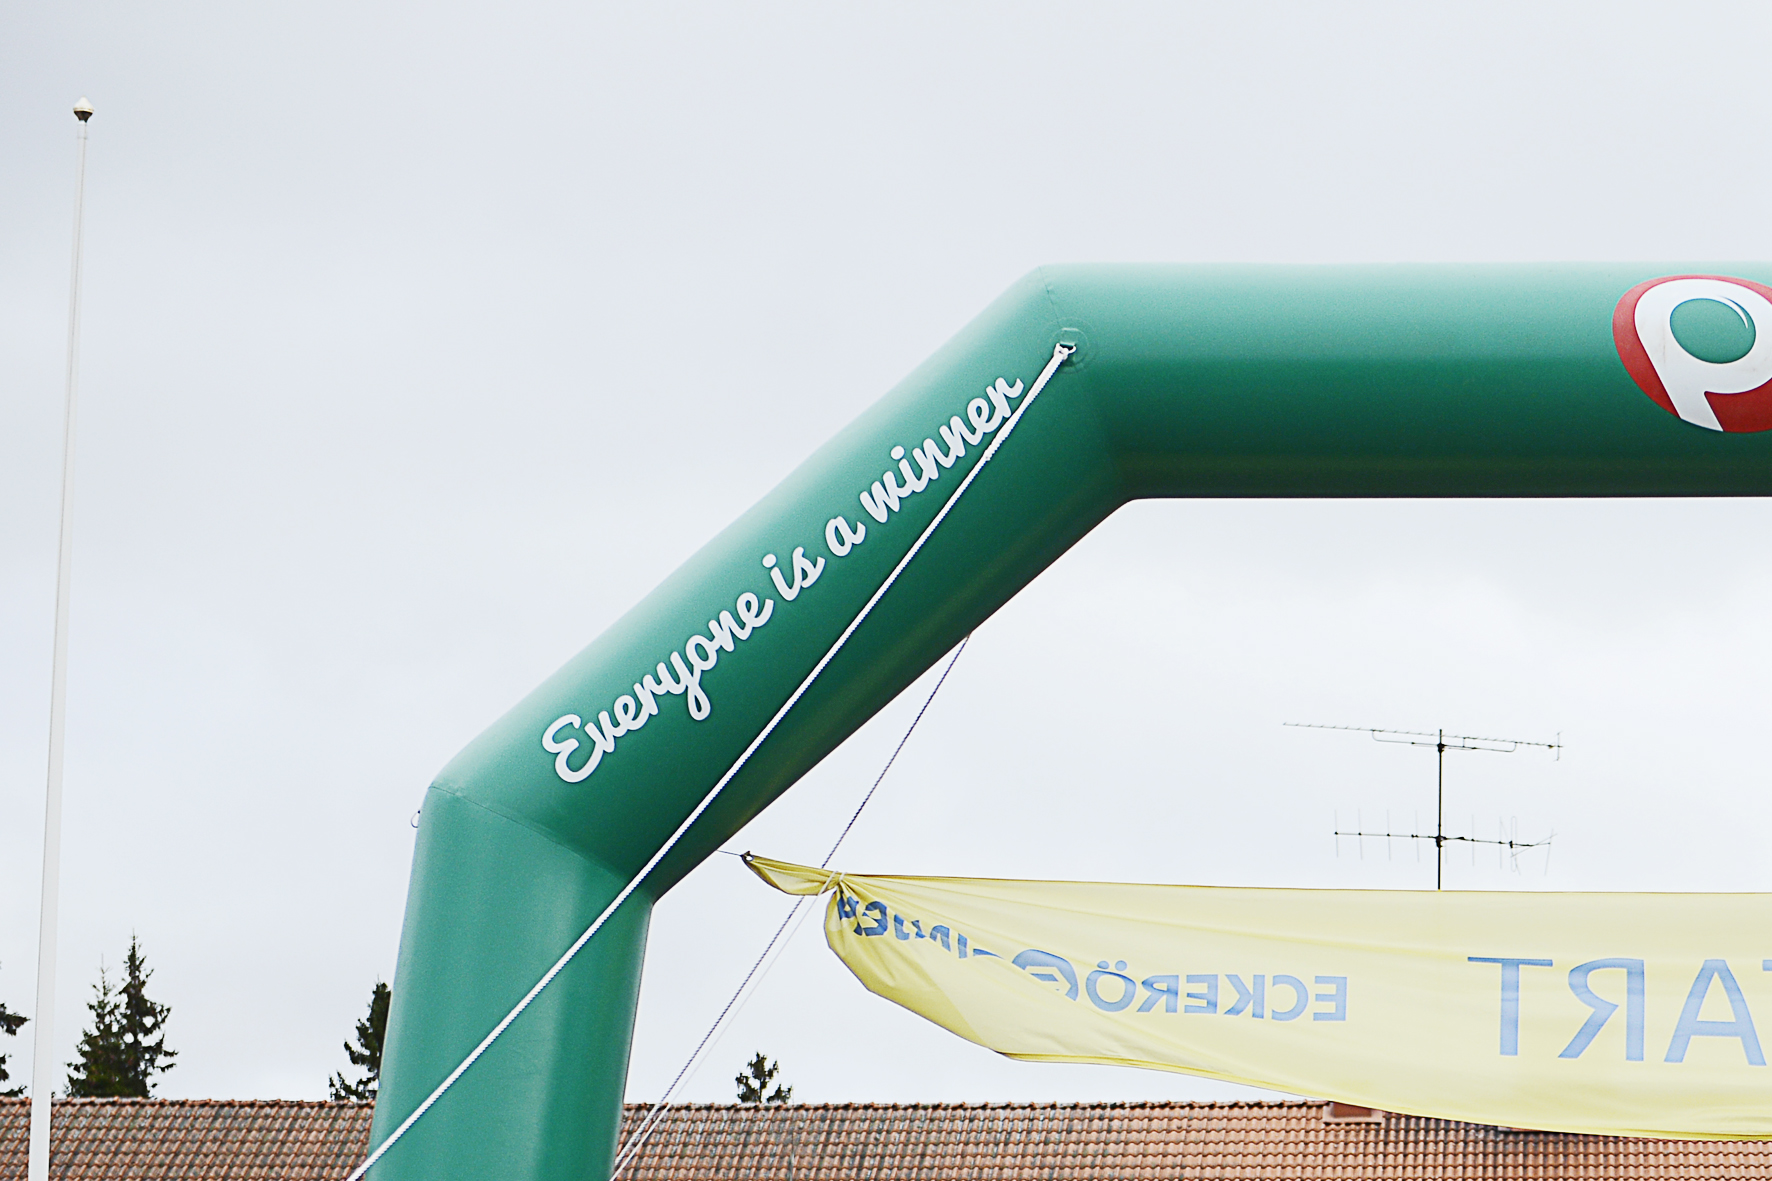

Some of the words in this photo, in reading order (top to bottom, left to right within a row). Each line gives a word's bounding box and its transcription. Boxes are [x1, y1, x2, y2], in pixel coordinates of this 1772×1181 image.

[541, 592, 774, 783] Everyone
[761, 546, 826, 601] is
[825, 516, 866, 556] a
[859, 376, 1024, 523] winner
